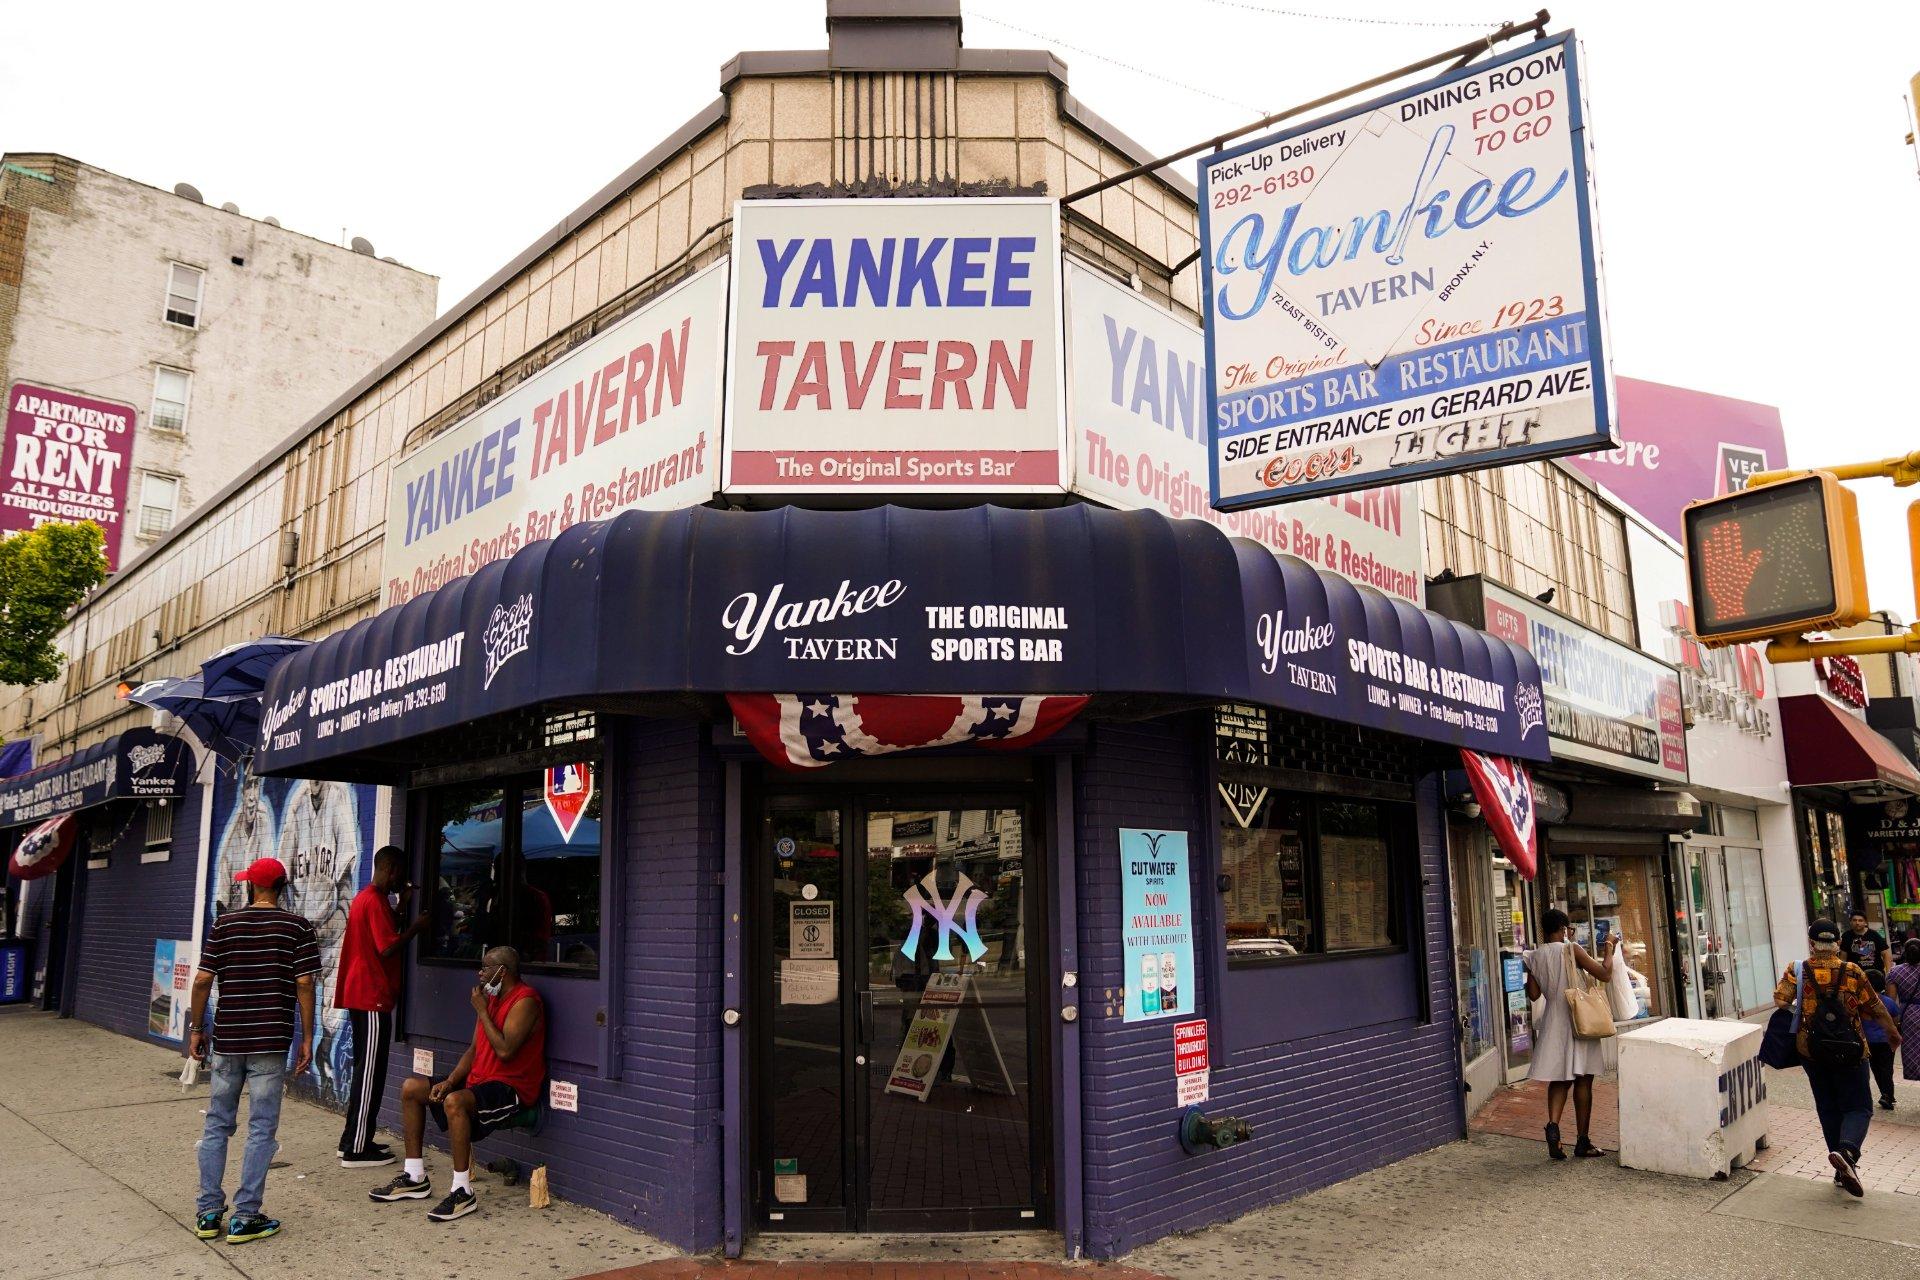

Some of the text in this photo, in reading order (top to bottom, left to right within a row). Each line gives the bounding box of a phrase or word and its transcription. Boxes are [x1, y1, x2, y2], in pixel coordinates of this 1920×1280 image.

[1399, 51, 1567, 123] DINING ROOM
[1471, 88, 1555, 131] FOOD
[1210, 128, 1347, 185] Pick-Up Delivery
[1474, 114, 1553, 156] TO GO
[1213, 164, 1315, 210] 292-6130
[1216, 124, 1569, 321] Yankee
[756, 236, 1037, 308] YANKEE
[1315, 266, 1436, 317] TAVERN
[1438, 238, 1495, 303] BRONX, N.Y.
[1271, 291, 1285, 306] 72
[1281, 301, 1305, 327] EAST
[1324, 335, 1339, 350] ST
[1414, 295, 1564, 346] Since 1923
[756, 339, 1034, 411] TAVERN
[1217, 320, 1588, 431] SPORTS BAR RESTAURANT
[1224, 347, 1350, 390] The Original
[14, 393, 127, 434] APARTMENTS
[32, 416, 109, 450] FOR
[404, 317, 692, 547] YANKEE TAVERN
[1224, 366, 1592, 463] SIDE ENTRANCE on GERARD AVE.
[10, 432, 122, 496] RENT
[775, 456, 1015, 481] The Original Sports Bar
[1255, 407, 1541, 489] Coors LIGHT
[1728, 457, 1760, 476] VEC
[1, 492, 120, 524] THROUGHOUT
[10, 481, 115, 510] ALL SIZES
[1085, 428, 1130, 488] The
[1291, 518, 1321, 564] Bar
[1325, 532, 1338, 572] &
[1340, 538, 1419, 602] Restaurant
[388, 430, 707, 607] The Original Sports Bar & Restaurant
[721, 578, 907, 656] Yankee
[925, 605, 1069, 631] THE ORIGINAL
[1496, 608, 1519, 633] GIFTS
[784, 636, 899, 661] TAVERN
[931, 637, 1063, 663] SPORTS BAR
[1256, 609, 1336, 675] Yankee
[309, 631, 465, 718] SPORTS BAR & RESTAURANT
[1287, 661, 1337, 696] TAVERN
[1347, 638, 1506, 712] SPORTS BAR & RESTAURANT
[260, 685, 308, 752] Yankee
[317, 718, 335, 739] LUNCH
[340, 709, 361, 733] DINNER
[367, 706, 380, 724] Free
[380, 698, 404, 719] Delivery
[1367, 684, 1391, 708] LUNCH
[1397, 692, 1423, 716] DINNER
[1429, 701, 1443, 720] Free
[1442, 704, 1465, 729] Delivery
[273, 728, 302, 751] TAVERN
[130, 776, 176, 786] Yankee
[131, 785, 174, 794] Tavern
[1866, 830, 1906, 838] VARIETY
[1880, 819, 1893, 829] D
[1897, 818, 1909, 829] &
[1131, 861, 1176, 876] CUTWATER
[794, 907, 829, 917] CLOSED
[901, 870, 988, 962] NY
[1131, 913, 1182, 929] AVAILABLE
[1145, 893, 1168, 907] NOW
[1127, 933, 1187, 947] WITH TAKEOUT!
[5, 952, 16, 996] BUD LIGHT
[1176, 1024, 1206, 1040] SPRINKLERS
[1177, 1039, 1206, 1056] THROUGHOUT
[1178, 1054, 1206, 1072] BUILDING
[1727, 1054, 1763, 1125] NYPD
